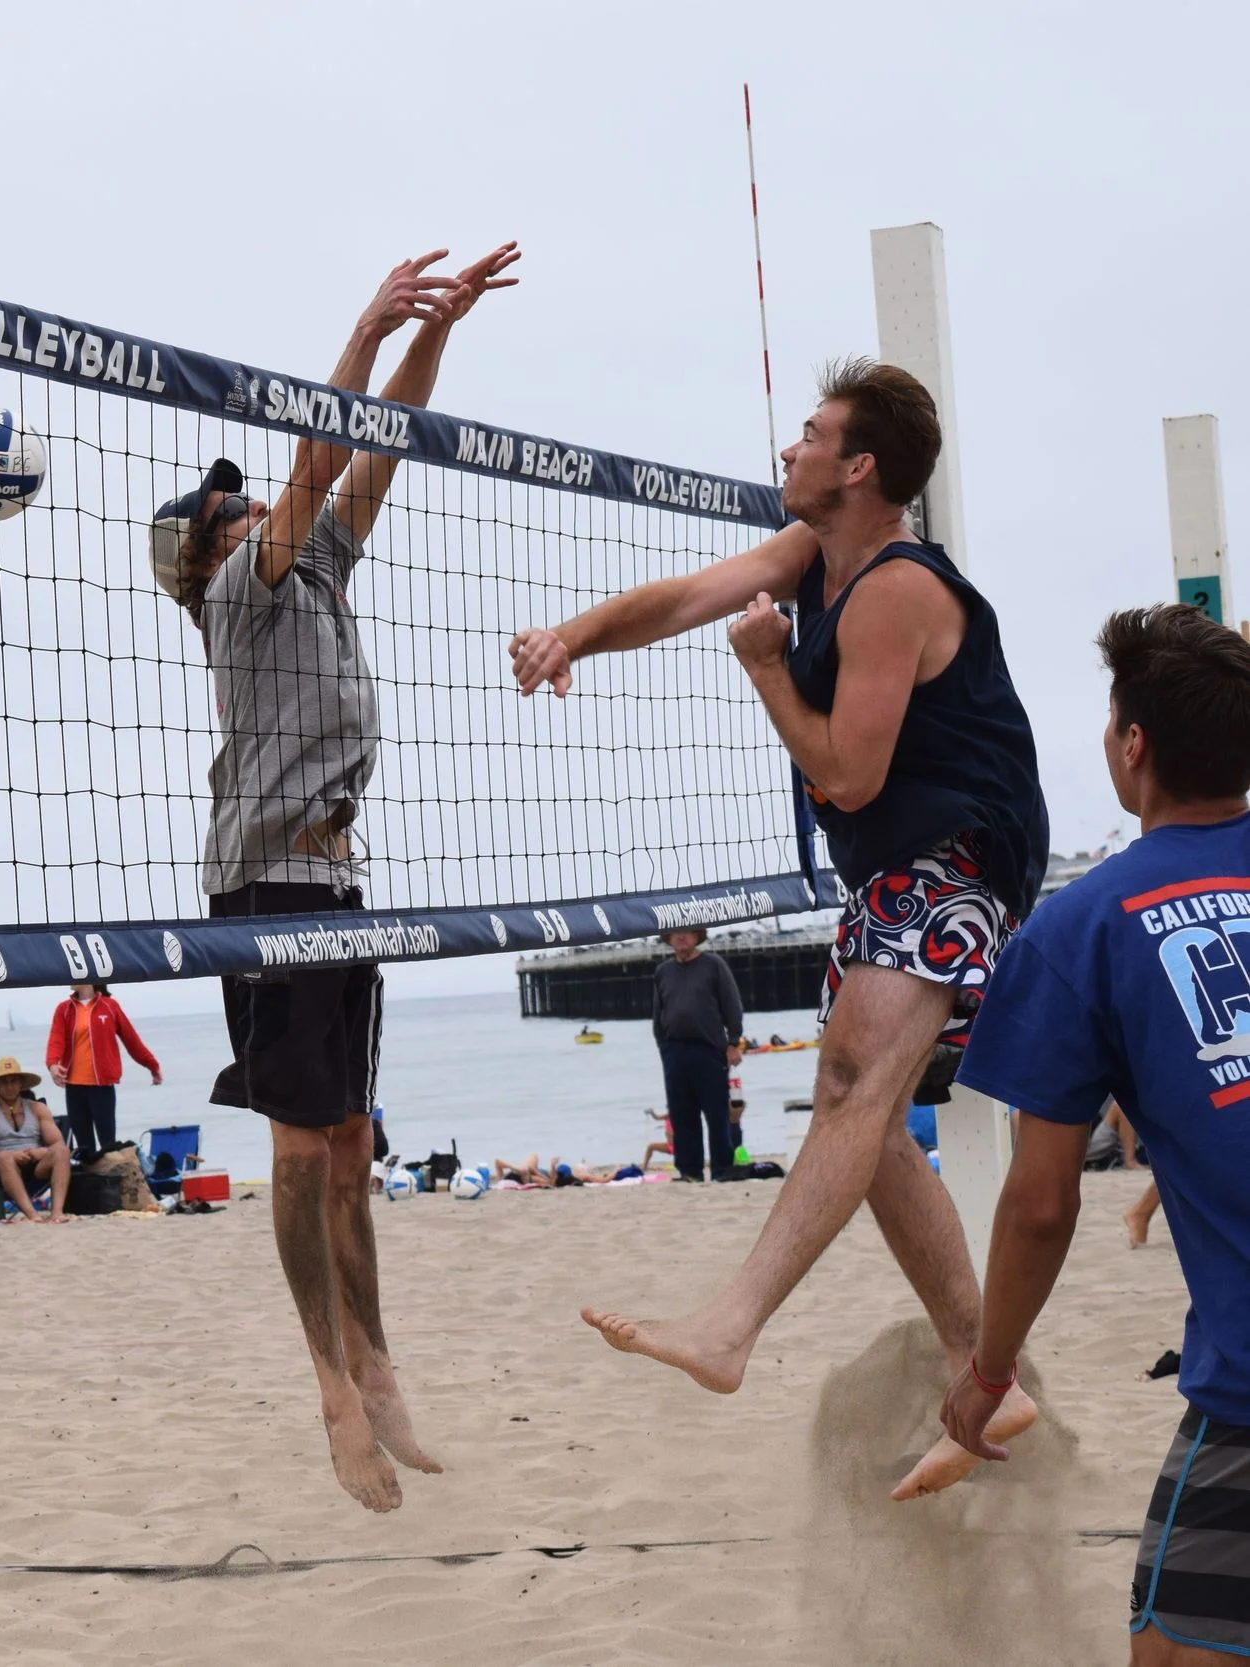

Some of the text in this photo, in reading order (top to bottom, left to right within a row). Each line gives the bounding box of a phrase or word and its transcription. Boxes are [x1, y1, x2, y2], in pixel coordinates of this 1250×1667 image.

[264, 379, 410, 450] SANTA CRUZ
[456, 426, 594, 487] MAIN BEACH
[632, 464, 743, 516] VOLLEYBALL
[652, 887, 774, 930] www.santacruzwharf.com
[1140, 892, 1250, 935] CALIFOR
[254, 918, 440, 966] www.santacruzwharf.com
[1209, 1054, 1250, 1086] VOL
